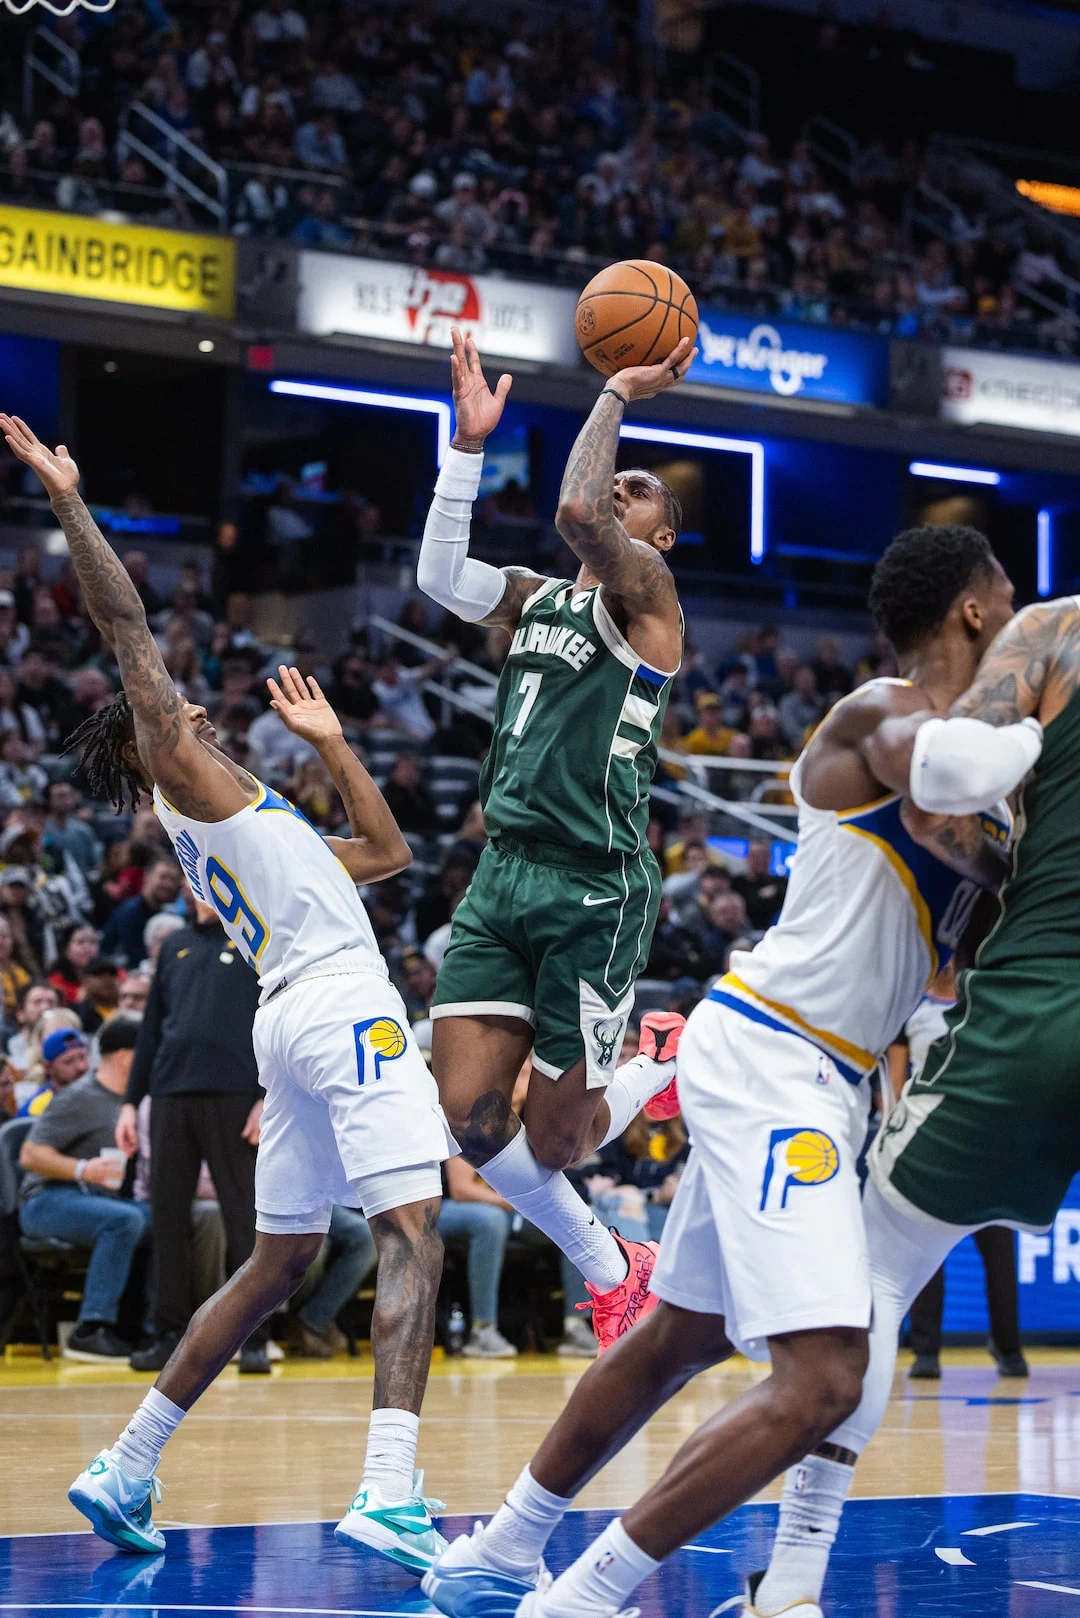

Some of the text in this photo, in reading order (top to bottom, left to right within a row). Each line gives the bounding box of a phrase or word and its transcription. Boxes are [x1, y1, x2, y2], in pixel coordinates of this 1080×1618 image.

[0, 224, 221, 299] GAINBRIDGE
[736, 324, 828, 396] Kroger
[512, 672, 543, 736] 7
[205, 854, 271, 978] 9
